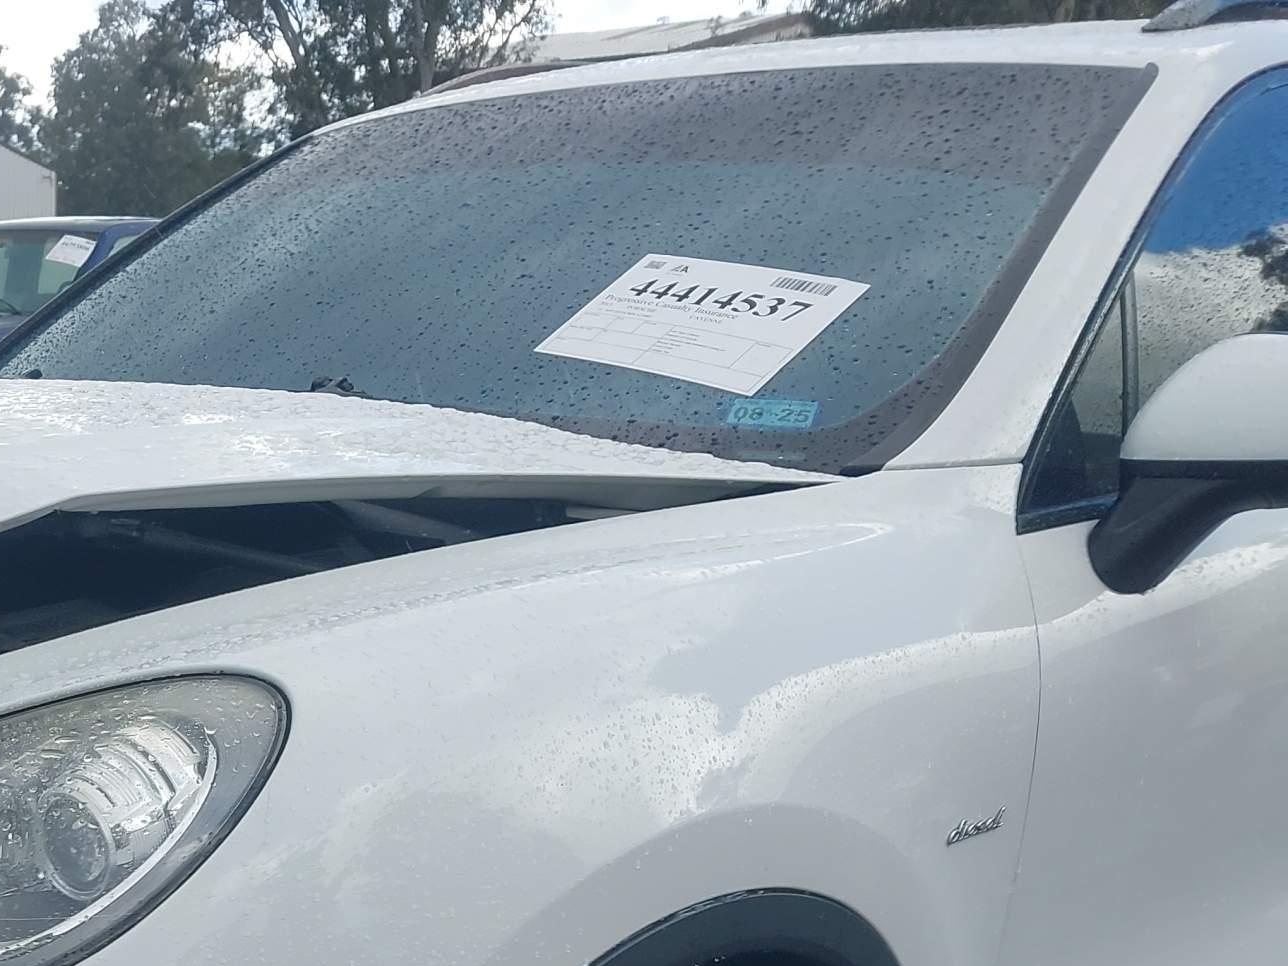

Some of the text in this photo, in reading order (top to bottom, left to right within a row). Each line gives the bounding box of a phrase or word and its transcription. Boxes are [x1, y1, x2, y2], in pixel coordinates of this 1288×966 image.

[605, 294, 655, 307] Progressive
[655, 300, 690, 313] Casualty
[694, 306, 738, 320] Insurance
[629, 279, 814, 321] 44414537
